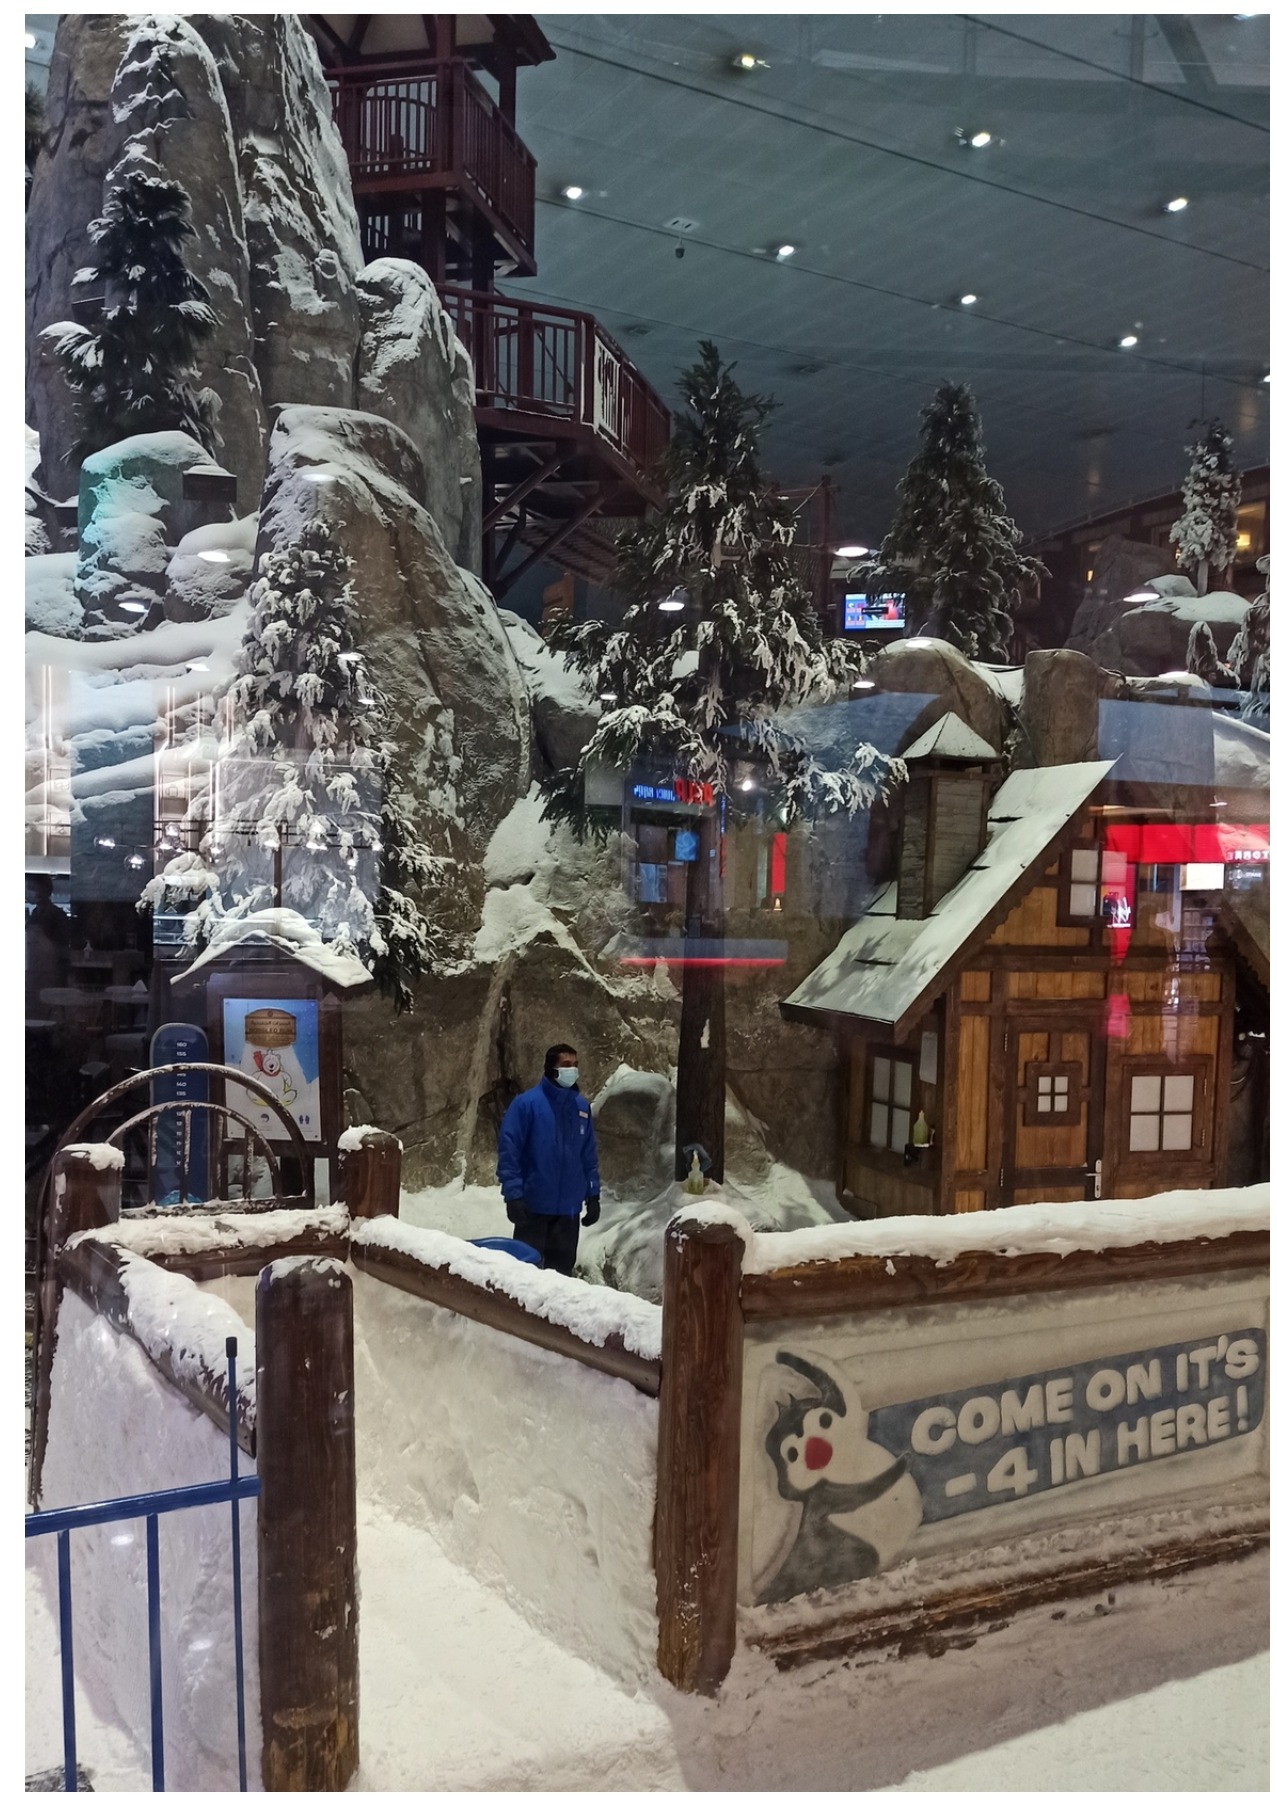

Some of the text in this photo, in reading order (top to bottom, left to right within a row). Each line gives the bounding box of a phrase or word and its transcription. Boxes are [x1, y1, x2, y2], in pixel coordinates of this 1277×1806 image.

[911, 1335, 1260, 1456] COME ON IT'S
[1050, 1428, 1100, 1486] IN
